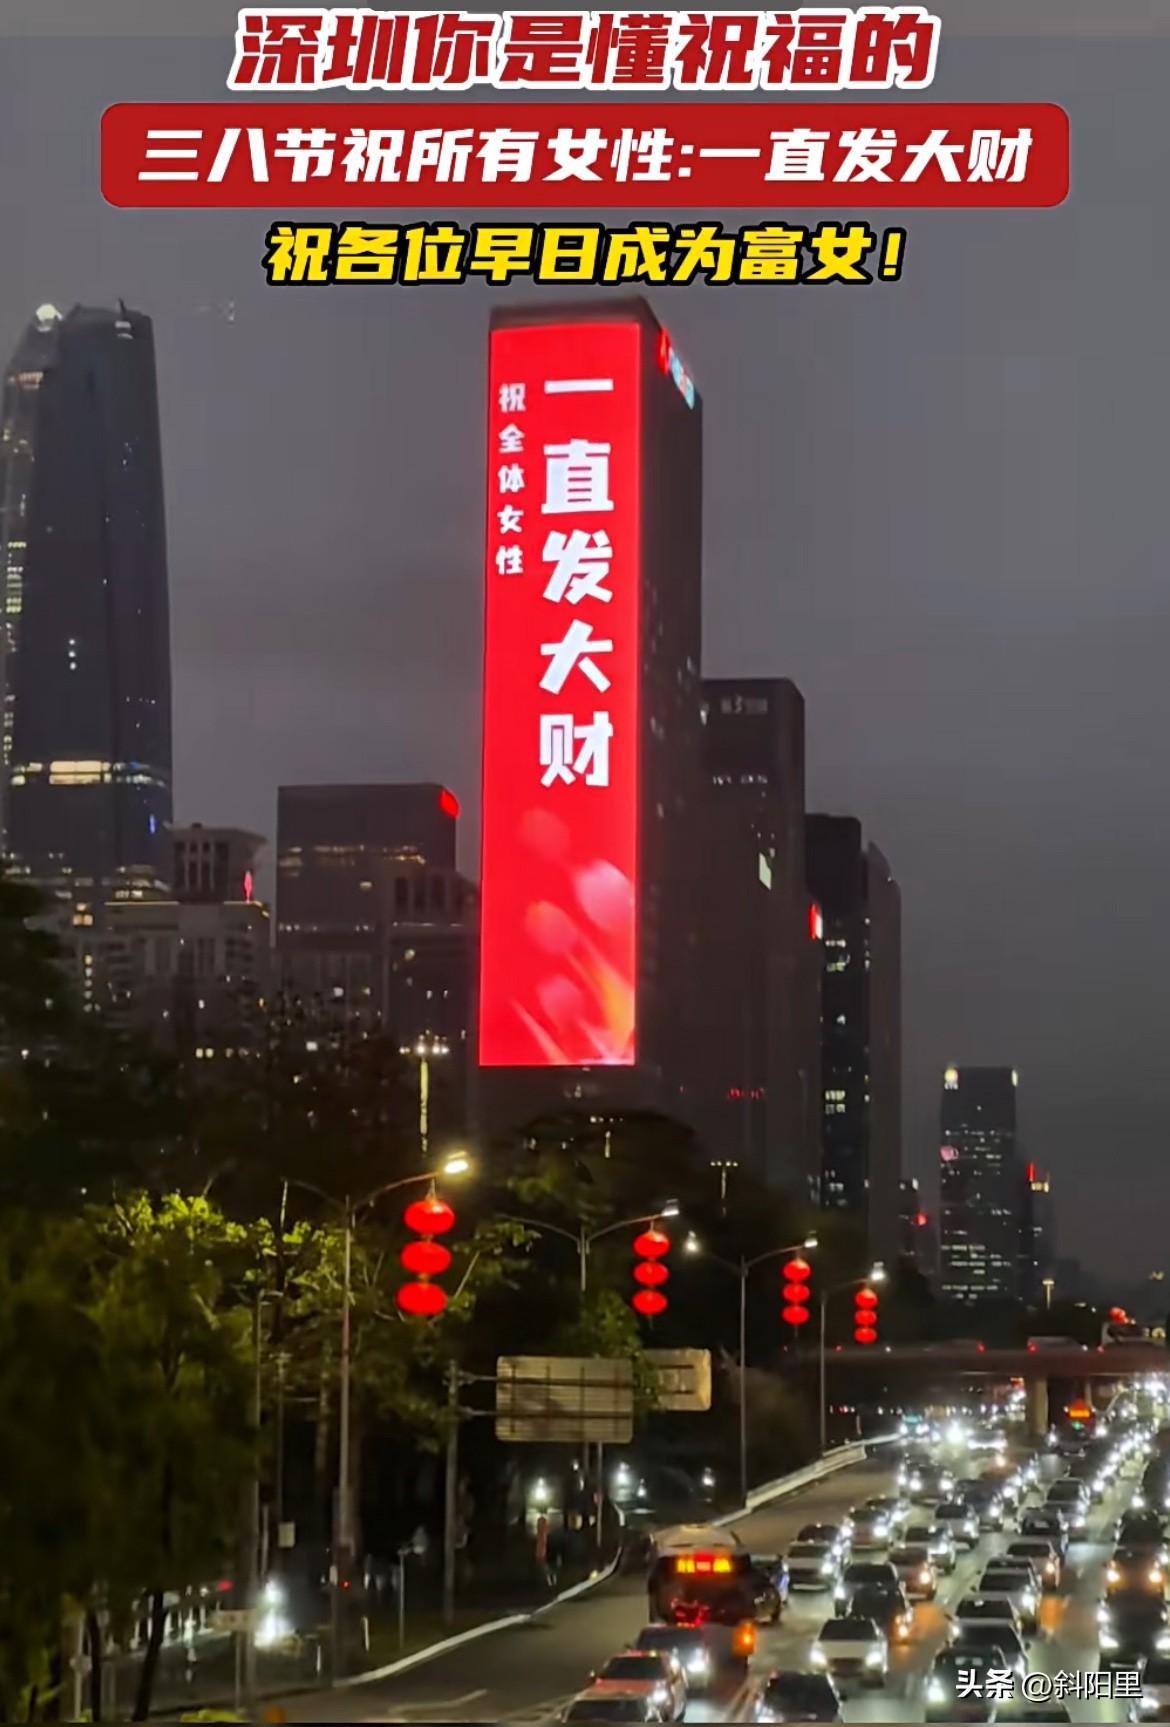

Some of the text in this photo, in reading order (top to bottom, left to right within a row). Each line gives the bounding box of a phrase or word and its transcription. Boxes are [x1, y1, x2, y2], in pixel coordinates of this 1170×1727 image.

[496, 383, 525, 576] 祝全体女性
[540, 378, 614, 788] 一直发大财
